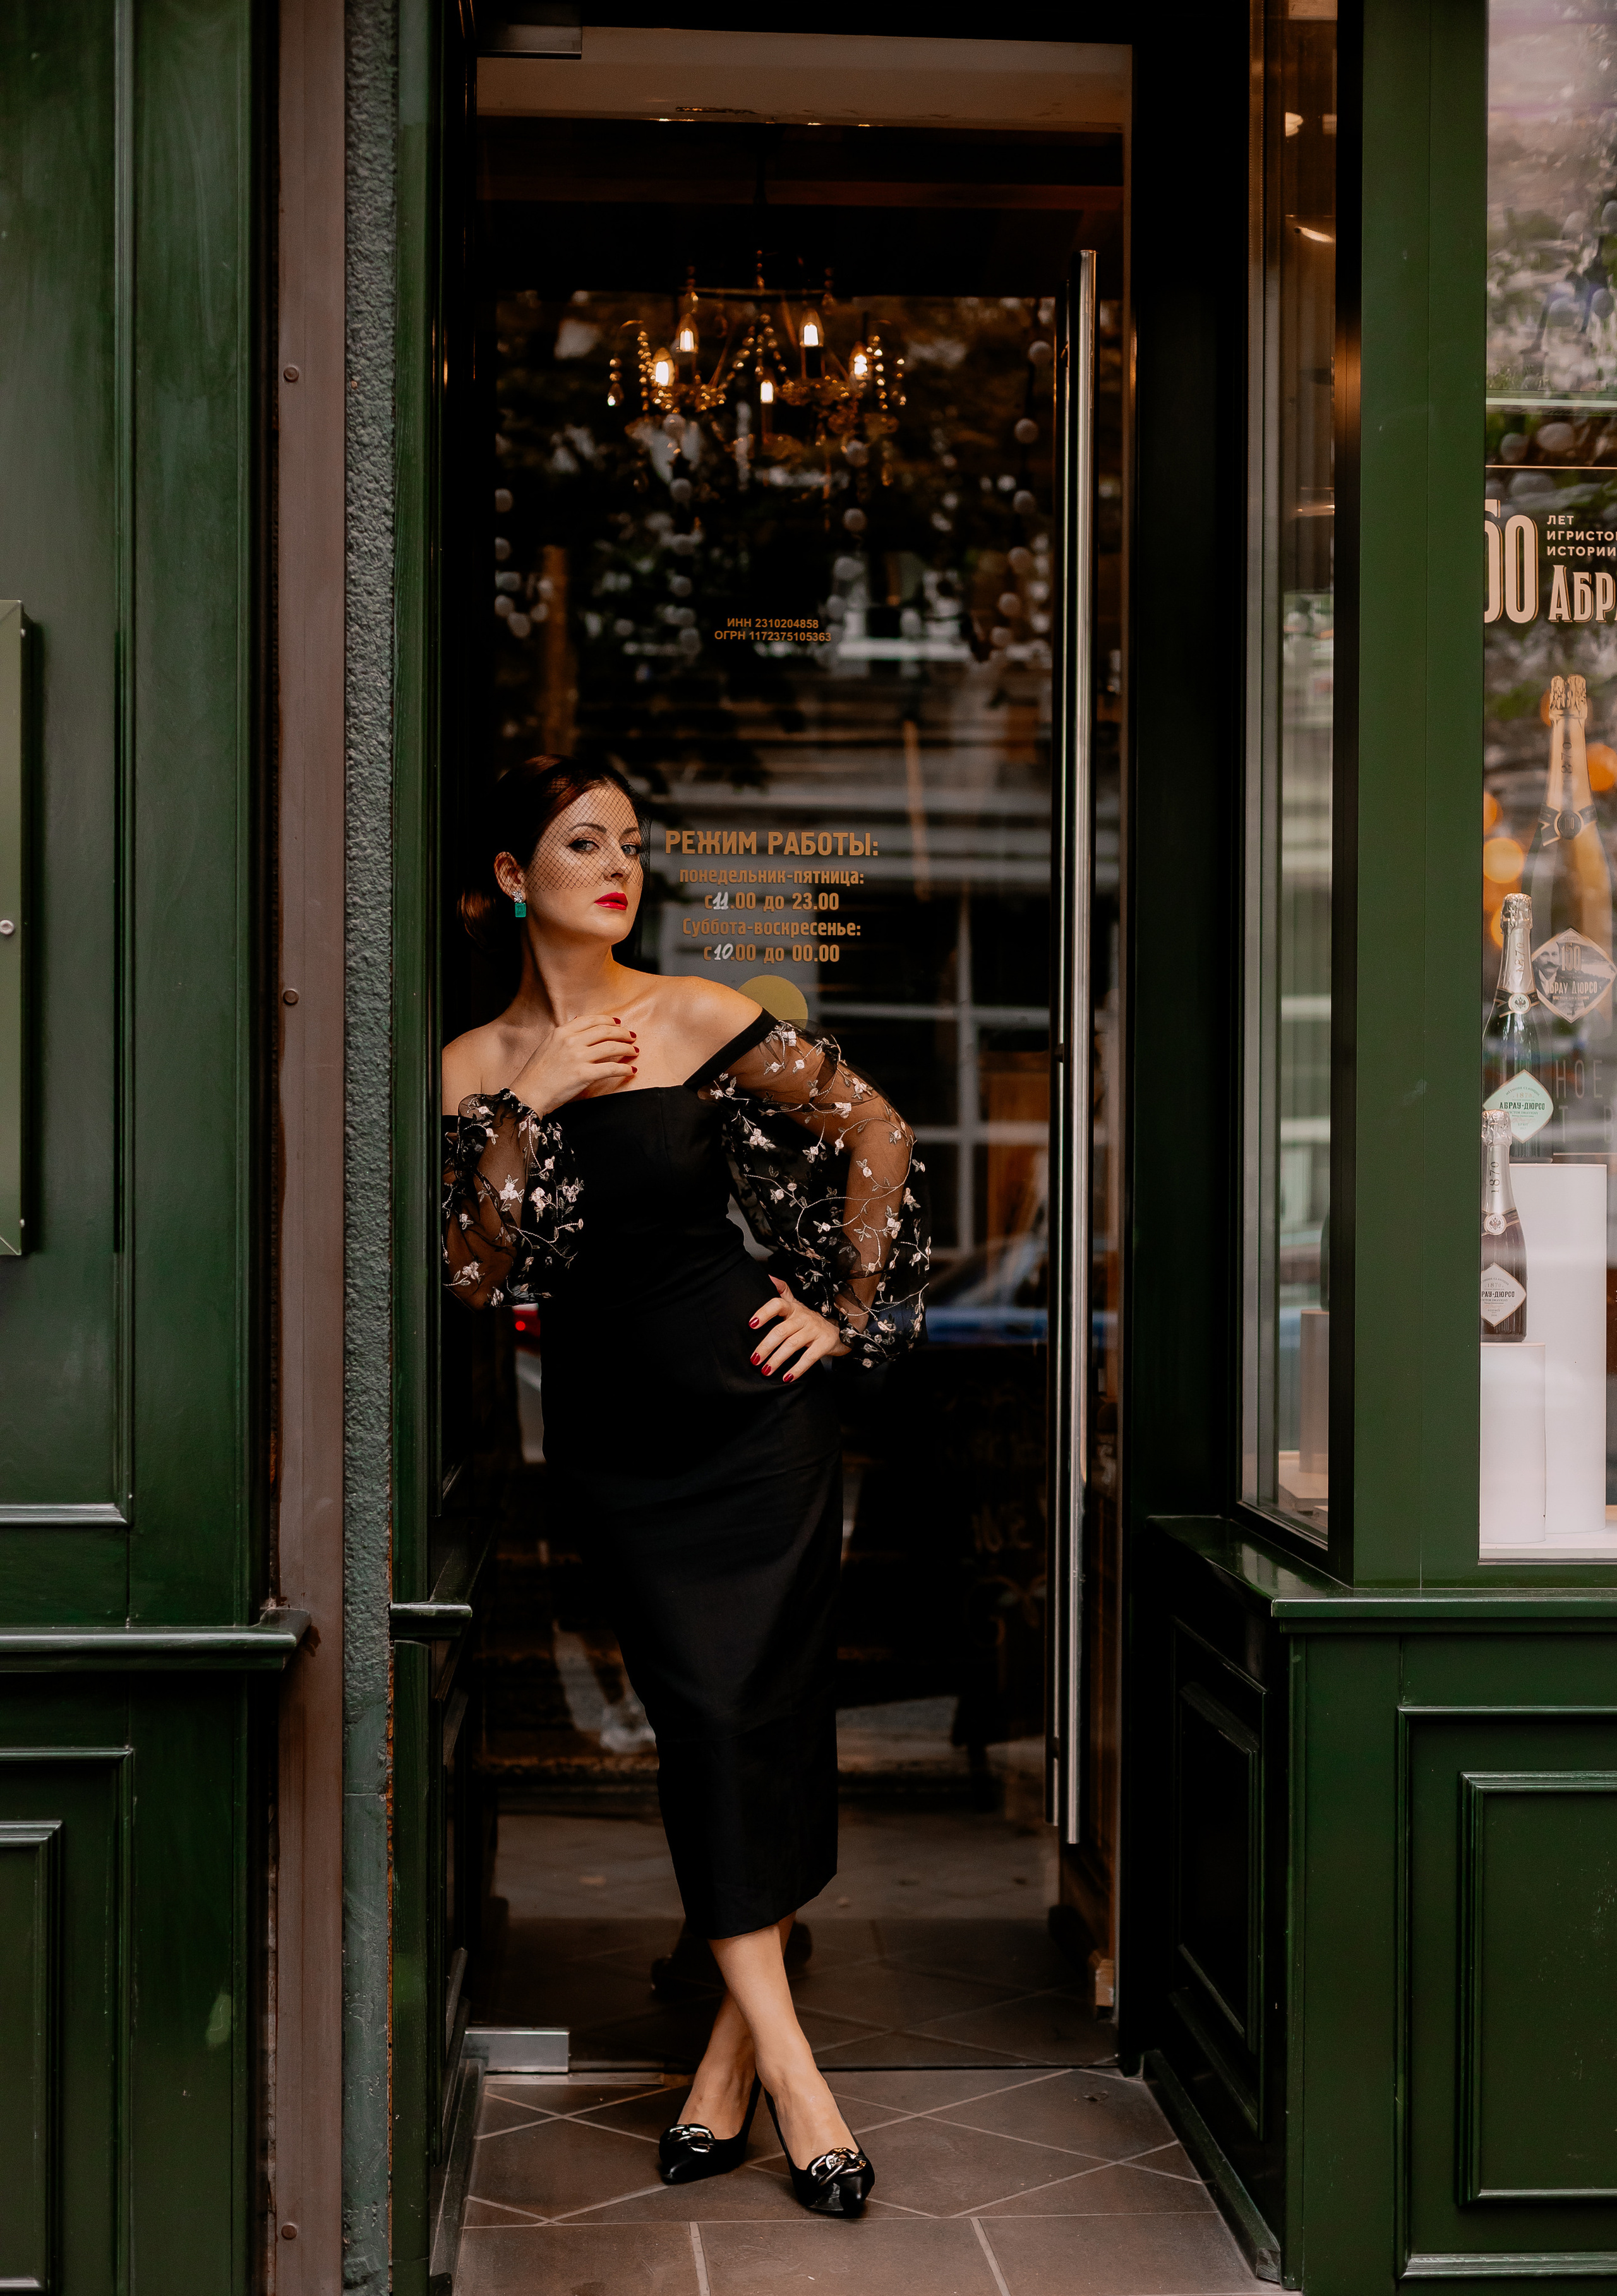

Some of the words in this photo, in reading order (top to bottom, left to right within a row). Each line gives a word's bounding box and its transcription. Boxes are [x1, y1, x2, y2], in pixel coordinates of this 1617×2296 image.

[1547, 515, 1574, 525] ЛЕТ
[1547, 530, 1617, 541] ИГРИСТО
[1547, 546, 1616, 557] ИСТОРИИ
[1548, 565, 1617, 623] АБР
[727, 618, 752, 627] ИНН
[755, 618, 819, 628] 2310204858
[714, 630, 746, 640] ОГРН
[748, 631, 831, 642] 1172375105363
[665, 830, 757, 854] РЕЖИМ
[767, 832, 879, 856] РАБОТЫ:
[680, 869, 864, 887] понедельник-пятница:
[763, 895, 784, 912] до
[792, 892, 839, 911] 23.00
[683, 918, 861, 938] Суббота-воскресенье:
[763, 947, 784, 964] до
[792, 945, 840, 962] 00.00
[1561, 942, 1582, 971] 150
[1499, 1101, 1546, 1111] АБРАУ-ДЮРСО
[1489, 1161, 1500, 1193] 1870
